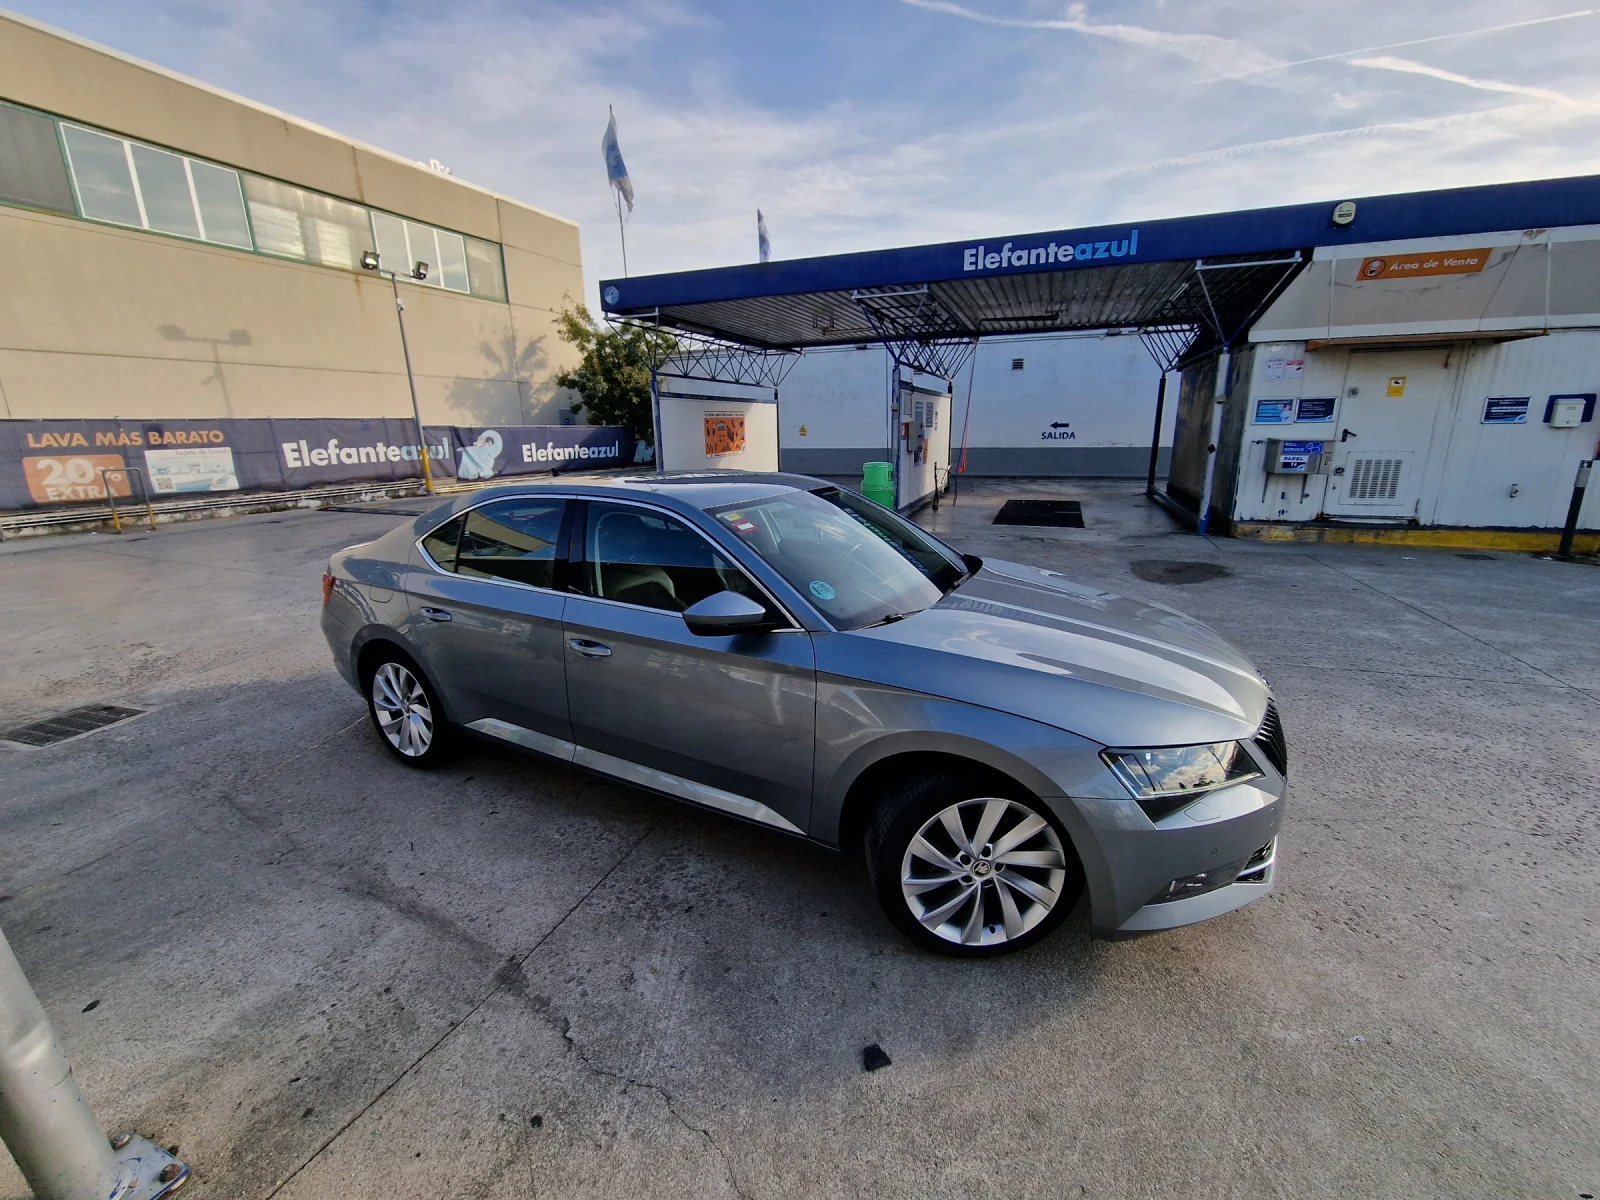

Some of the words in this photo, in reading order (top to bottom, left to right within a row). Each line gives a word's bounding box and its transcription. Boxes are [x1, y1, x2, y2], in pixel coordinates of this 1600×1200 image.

[963, 229, 1139, 271] Elefanteazul
[1390, 261, 1420, 271] Área
[1424, 260, 1439, 269] de
[1444, 257, 1479, 267] Venta
[26, 432, 89, 448] LAVA
[95, 428, 143, 447] MÁS
[148, 430, 224, 445] BARATO
[1041, 431, 1076, 440] SALIDA
[521, 439, 619, 463] Elefanteazul
[37, 458, 122, 486] 20%
[46, 485, 118, 500] EXTRA
